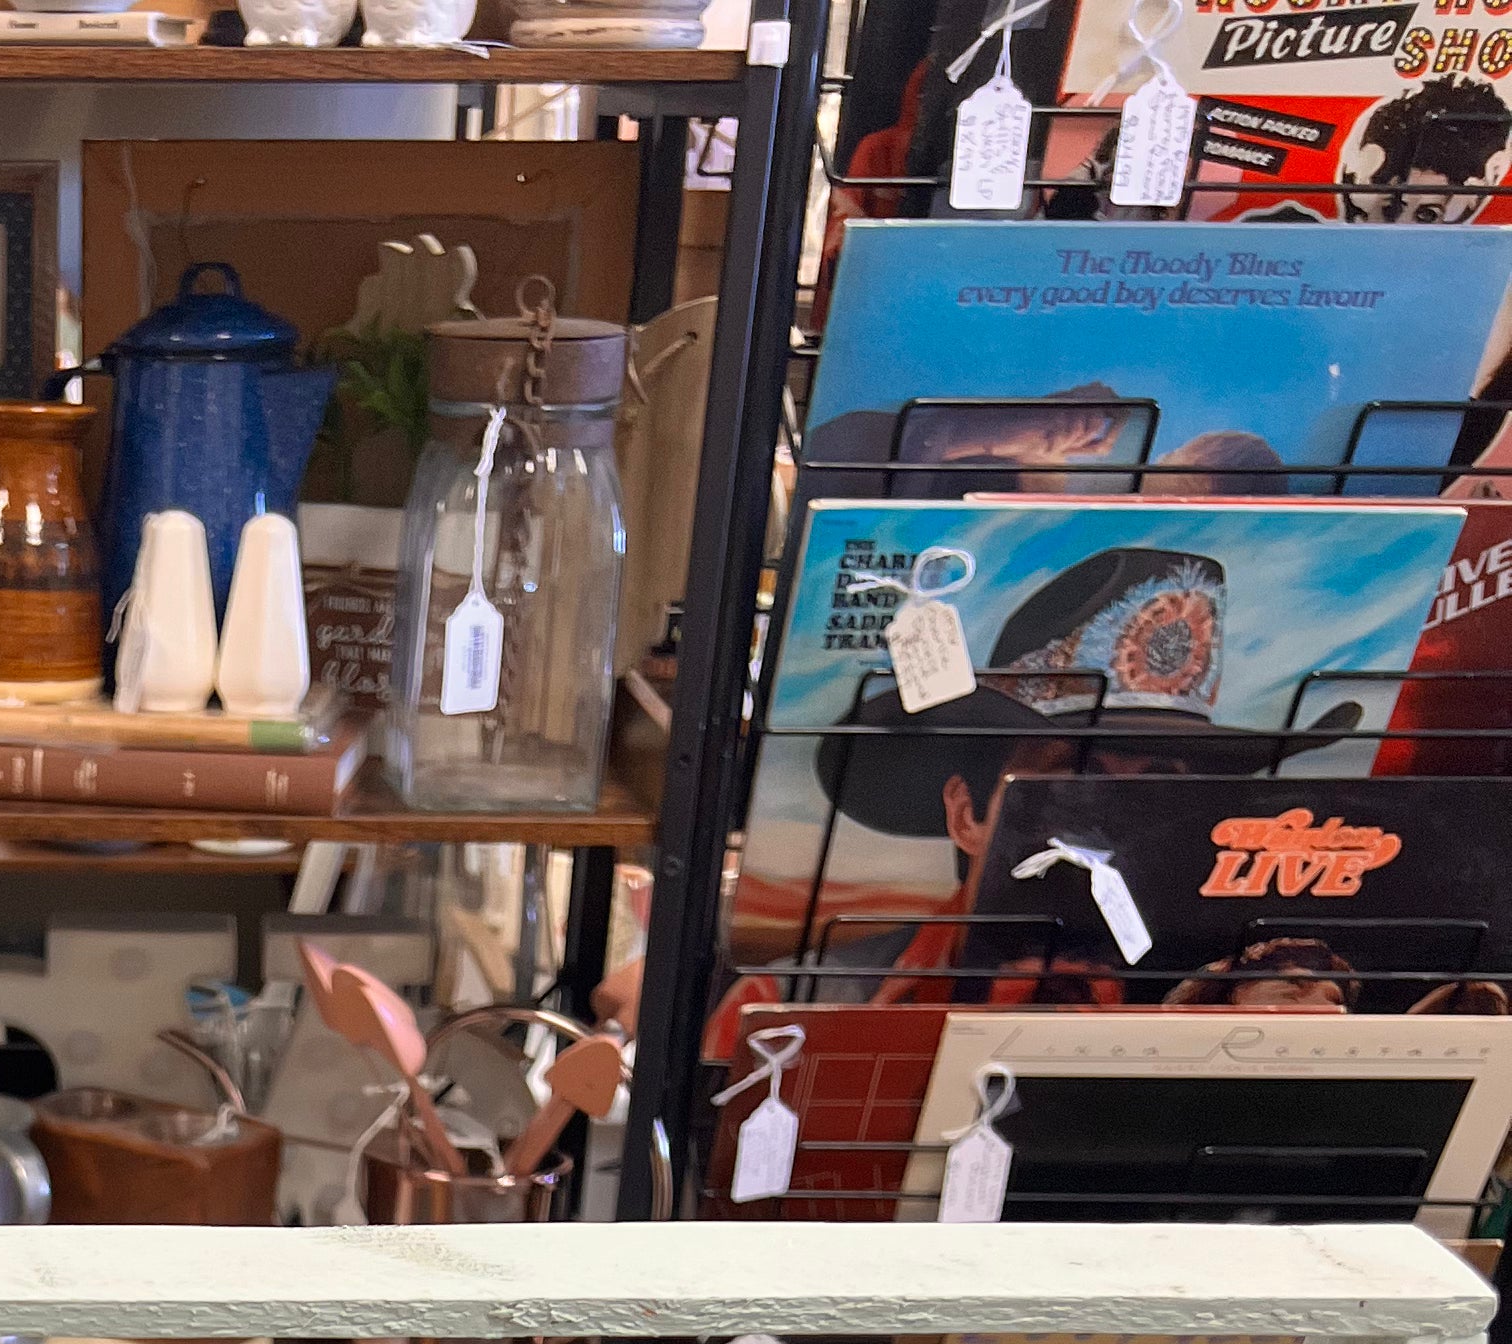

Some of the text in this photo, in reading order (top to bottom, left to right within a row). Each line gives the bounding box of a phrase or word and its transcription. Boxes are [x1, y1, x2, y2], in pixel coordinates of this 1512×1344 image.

[1224, 14, 1397, 63] Picture
[1056, 248, 1304, 284] The Moody Blues
[957, 280, 1386, 313] every good boy deserves favour
[1198, 850, 1374, 898] LIVE
